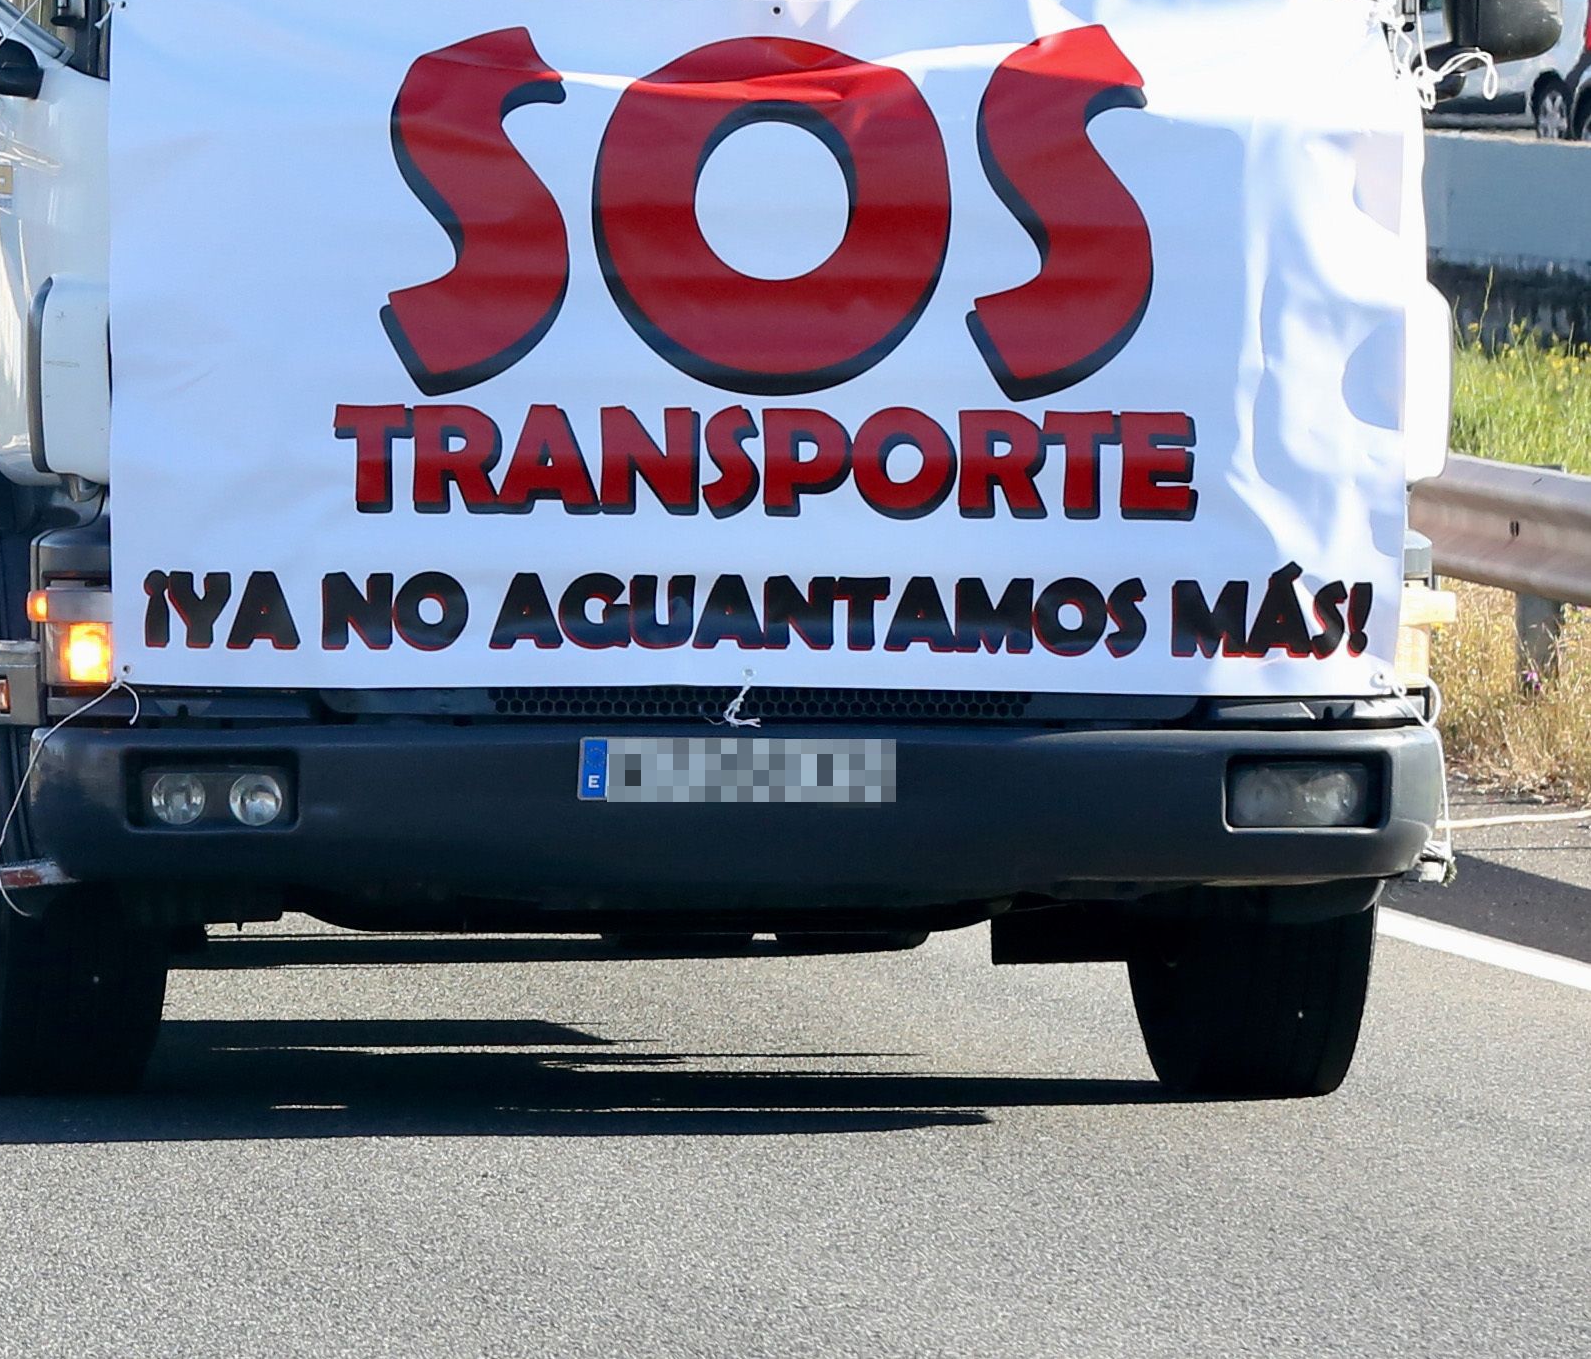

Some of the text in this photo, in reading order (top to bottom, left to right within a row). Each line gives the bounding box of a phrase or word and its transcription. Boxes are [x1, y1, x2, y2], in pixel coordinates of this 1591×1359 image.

[381, 24, 1153, 402] SOS
[335, 404, 1196, 520] TRANSPORTE
[143, 561, 1373, 660] ¡YA NO AGUANTAMOS MÁS!
[588, 775, 600, 789] E
